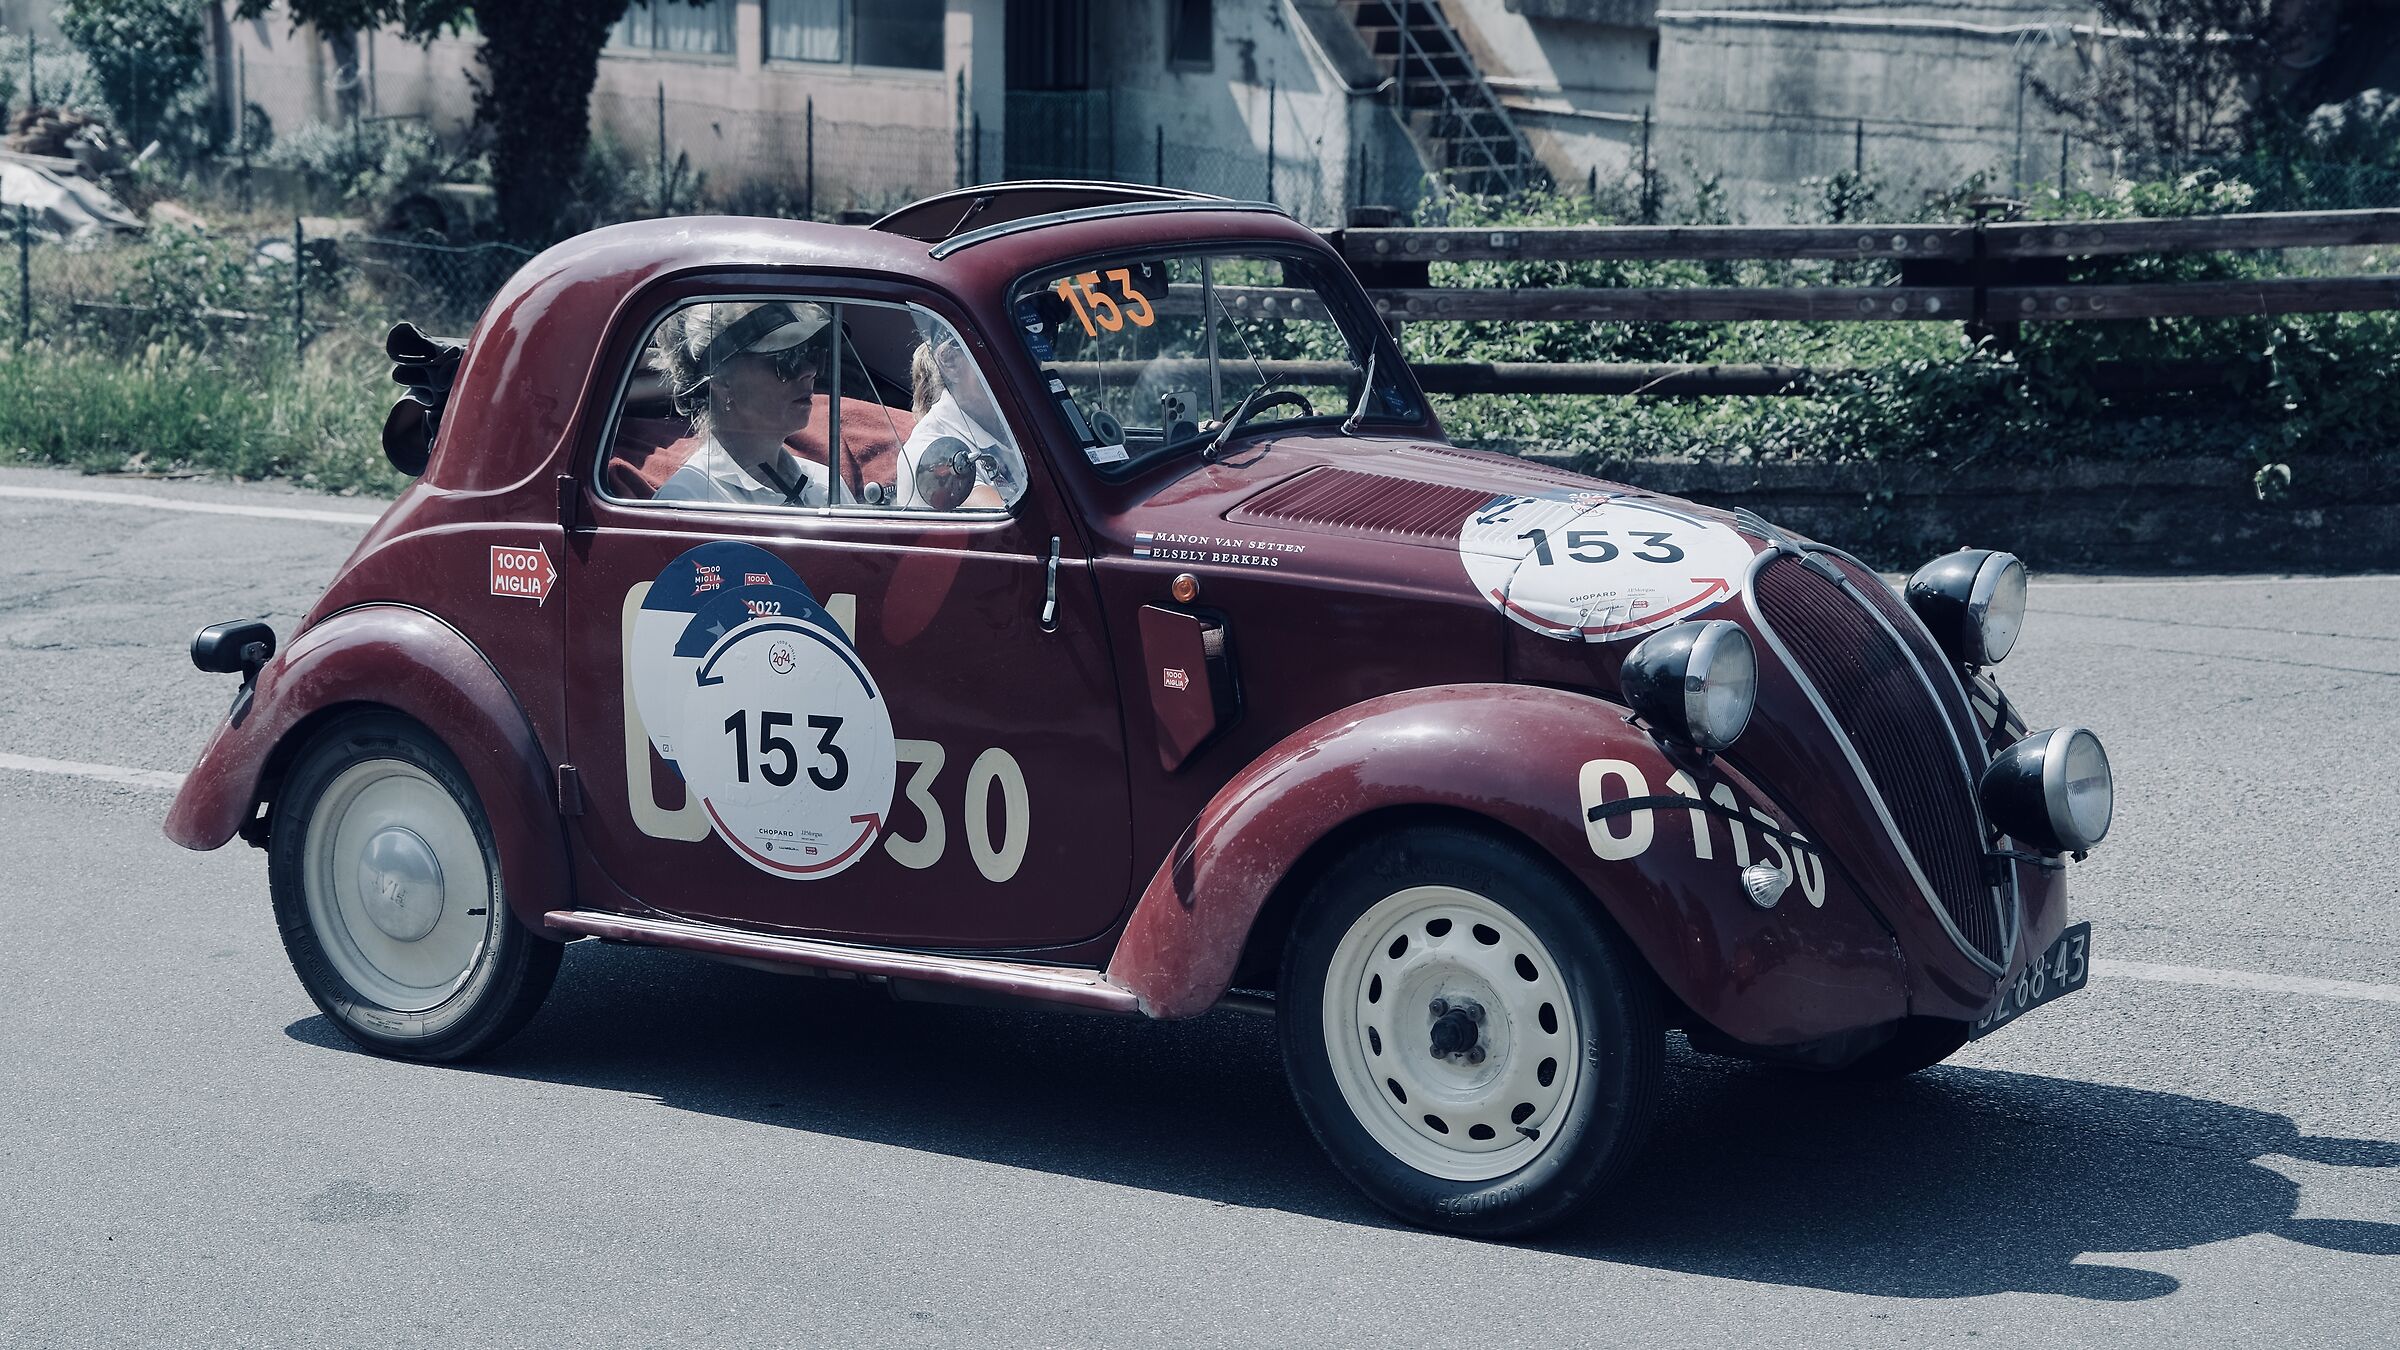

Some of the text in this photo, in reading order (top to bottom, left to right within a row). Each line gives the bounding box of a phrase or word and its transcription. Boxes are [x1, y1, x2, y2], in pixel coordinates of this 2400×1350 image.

[1057, 268, 1155, 337] 153
[1155, 531, 1306, 554] MANON VAN SETTEN
[1518, 528, 1686, 567] 153
[496, 552, 538, 572] 1000
[1153, 547, 1279, 567] ELSELY BERKERS
[694, 574, 721, 583] MIGLIA
[695, 565, 721, 574] 1000
[495, 574, 541, 595] MIGLIA
[695, 584, 720, 592] 2019
[1569, 591, 1617, 603] CHOPARD
[747, 600, 781, 615] 2022
[772, 649, 791, 667] 2024
[1165, 679, 1183, 687] MIGLIA
[724, 709, 849, 792] 153
[758, 828, 794, 837] CHOPARD
